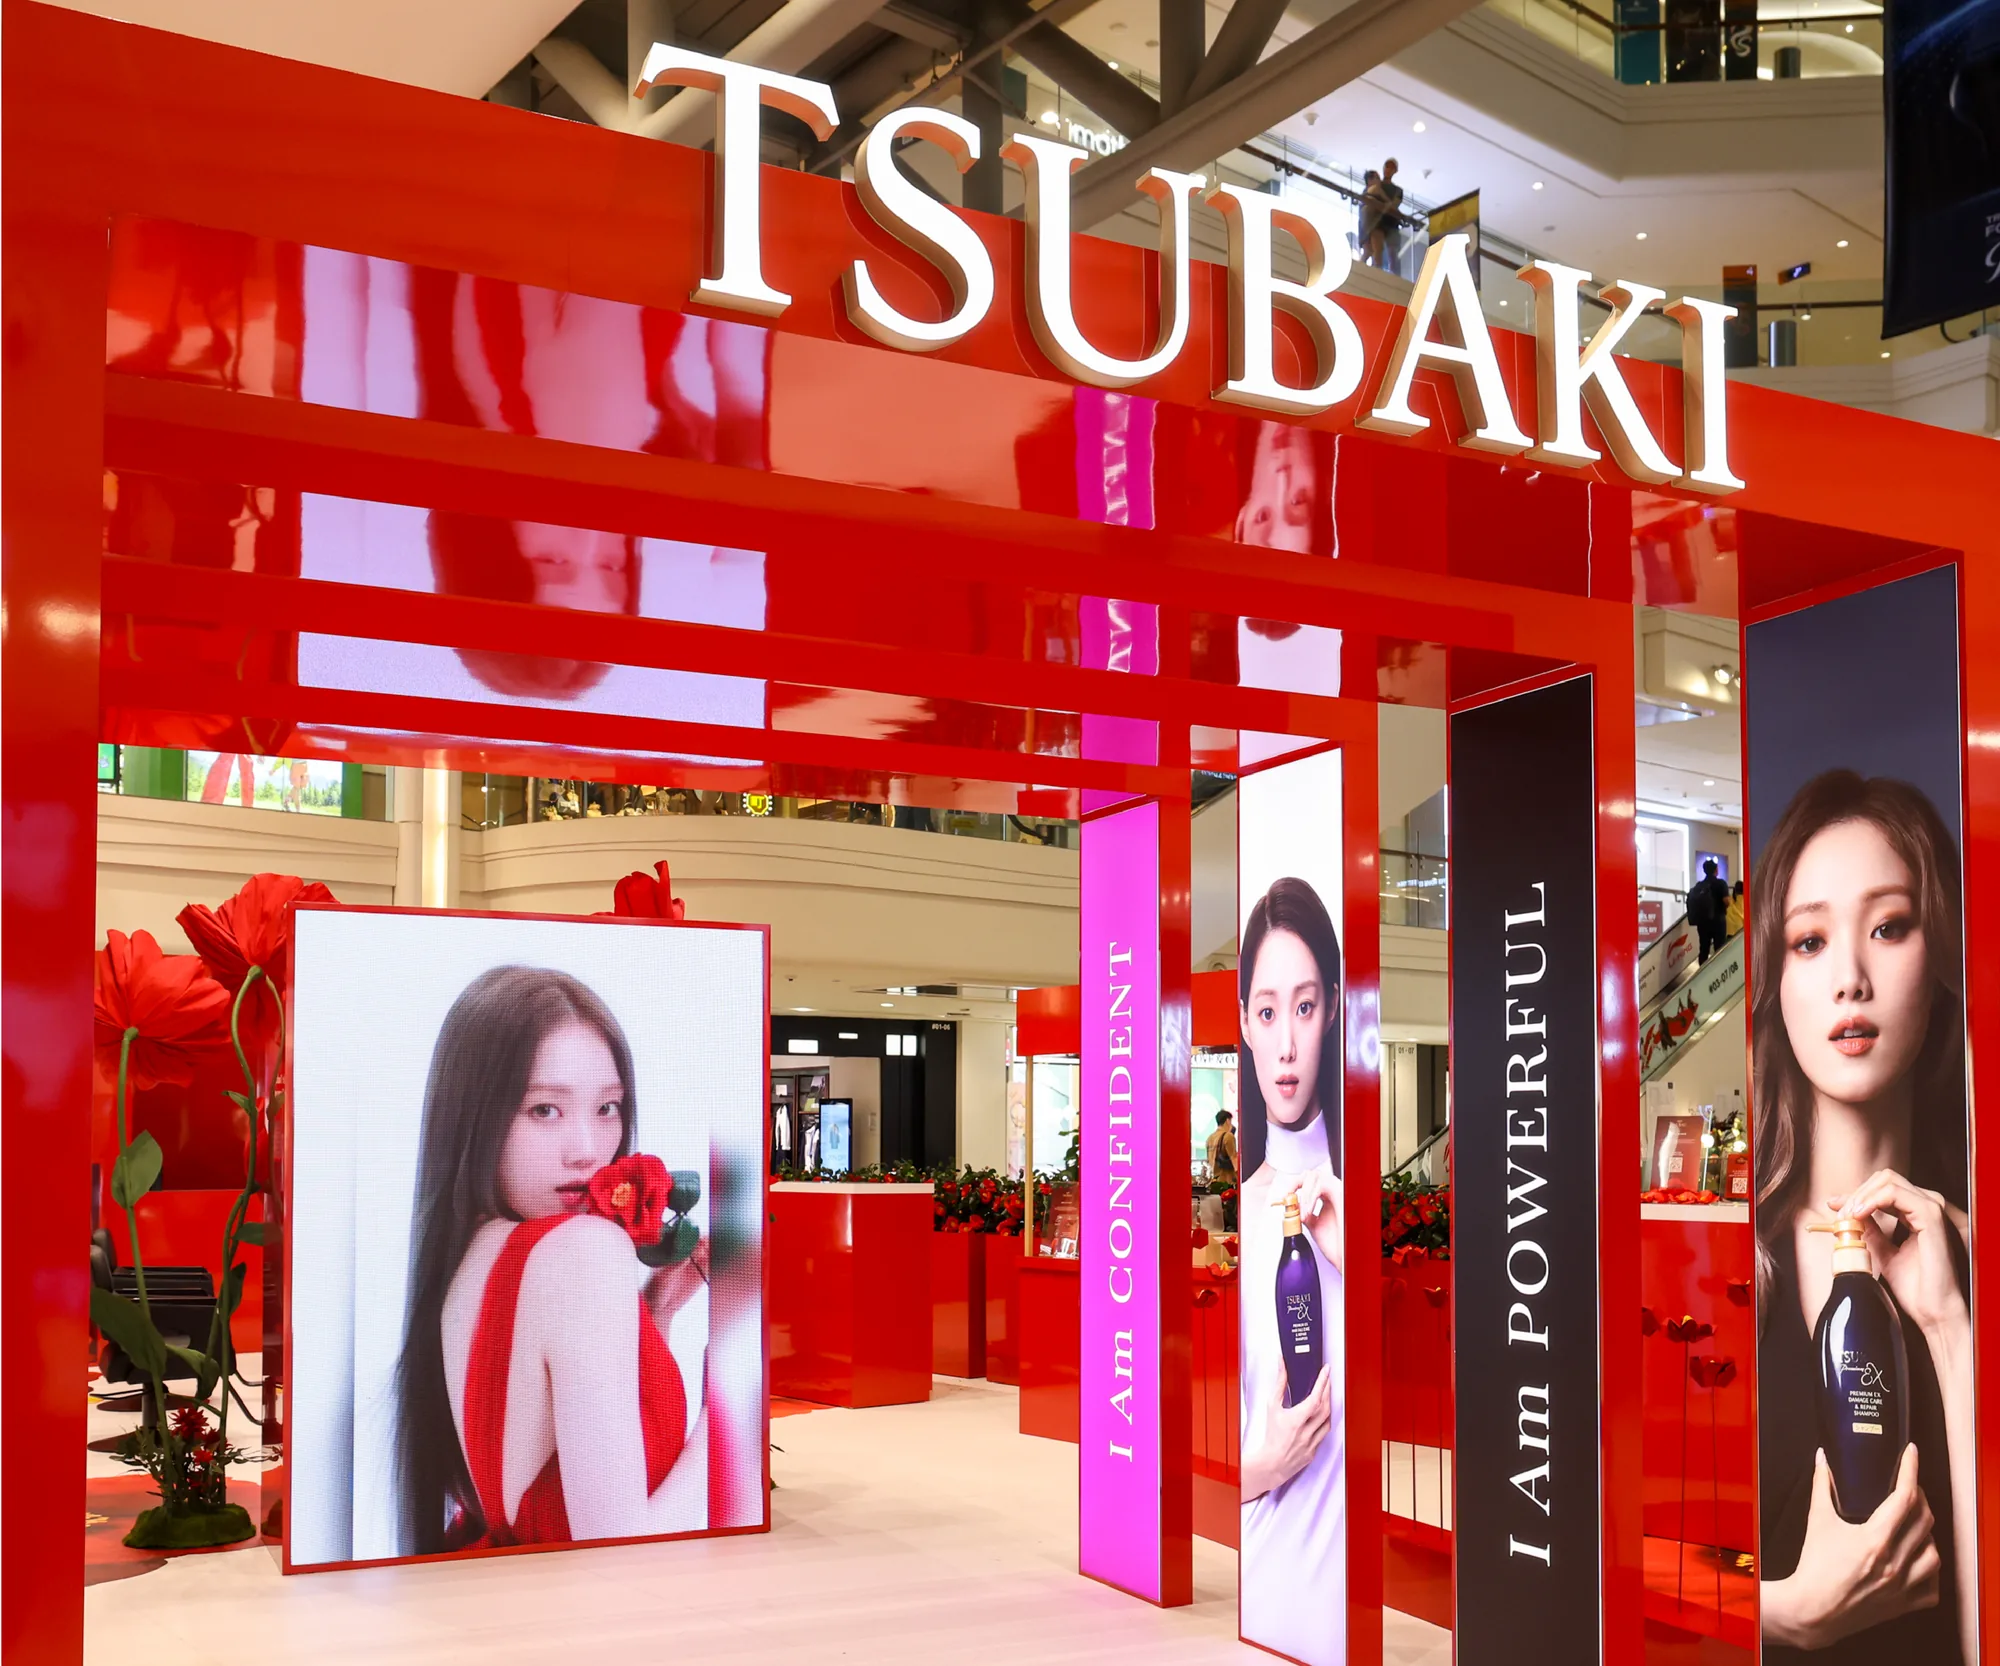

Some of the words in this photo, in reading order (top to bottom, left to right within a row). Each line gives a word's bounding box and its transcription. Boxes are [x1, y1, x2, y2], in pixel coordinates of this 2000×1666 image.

[640, 42, 1746, 491] TSUBAKI
[1708, 961, 1739, 994] #03-07/08
[1109, 941, 1132, 1303] CONFIDENT
[1505, 881, 1549, 1351] POWERFUL
[1109, 1329, 1132, 1425] Am
[1849, 1390, 1873, 1398] PREMIUM
[1848, 1396, 1869, 1404] DAMAGE
[1869, 1397, 1883, 1405] CARE
[1853, 1410, 1880, 1418] SHAMPOO
[1109, 1440, 1132, 1462] I
[1509, 1383, 1549, 1517] Am
[1509, 1534, 1550, 1568] I
